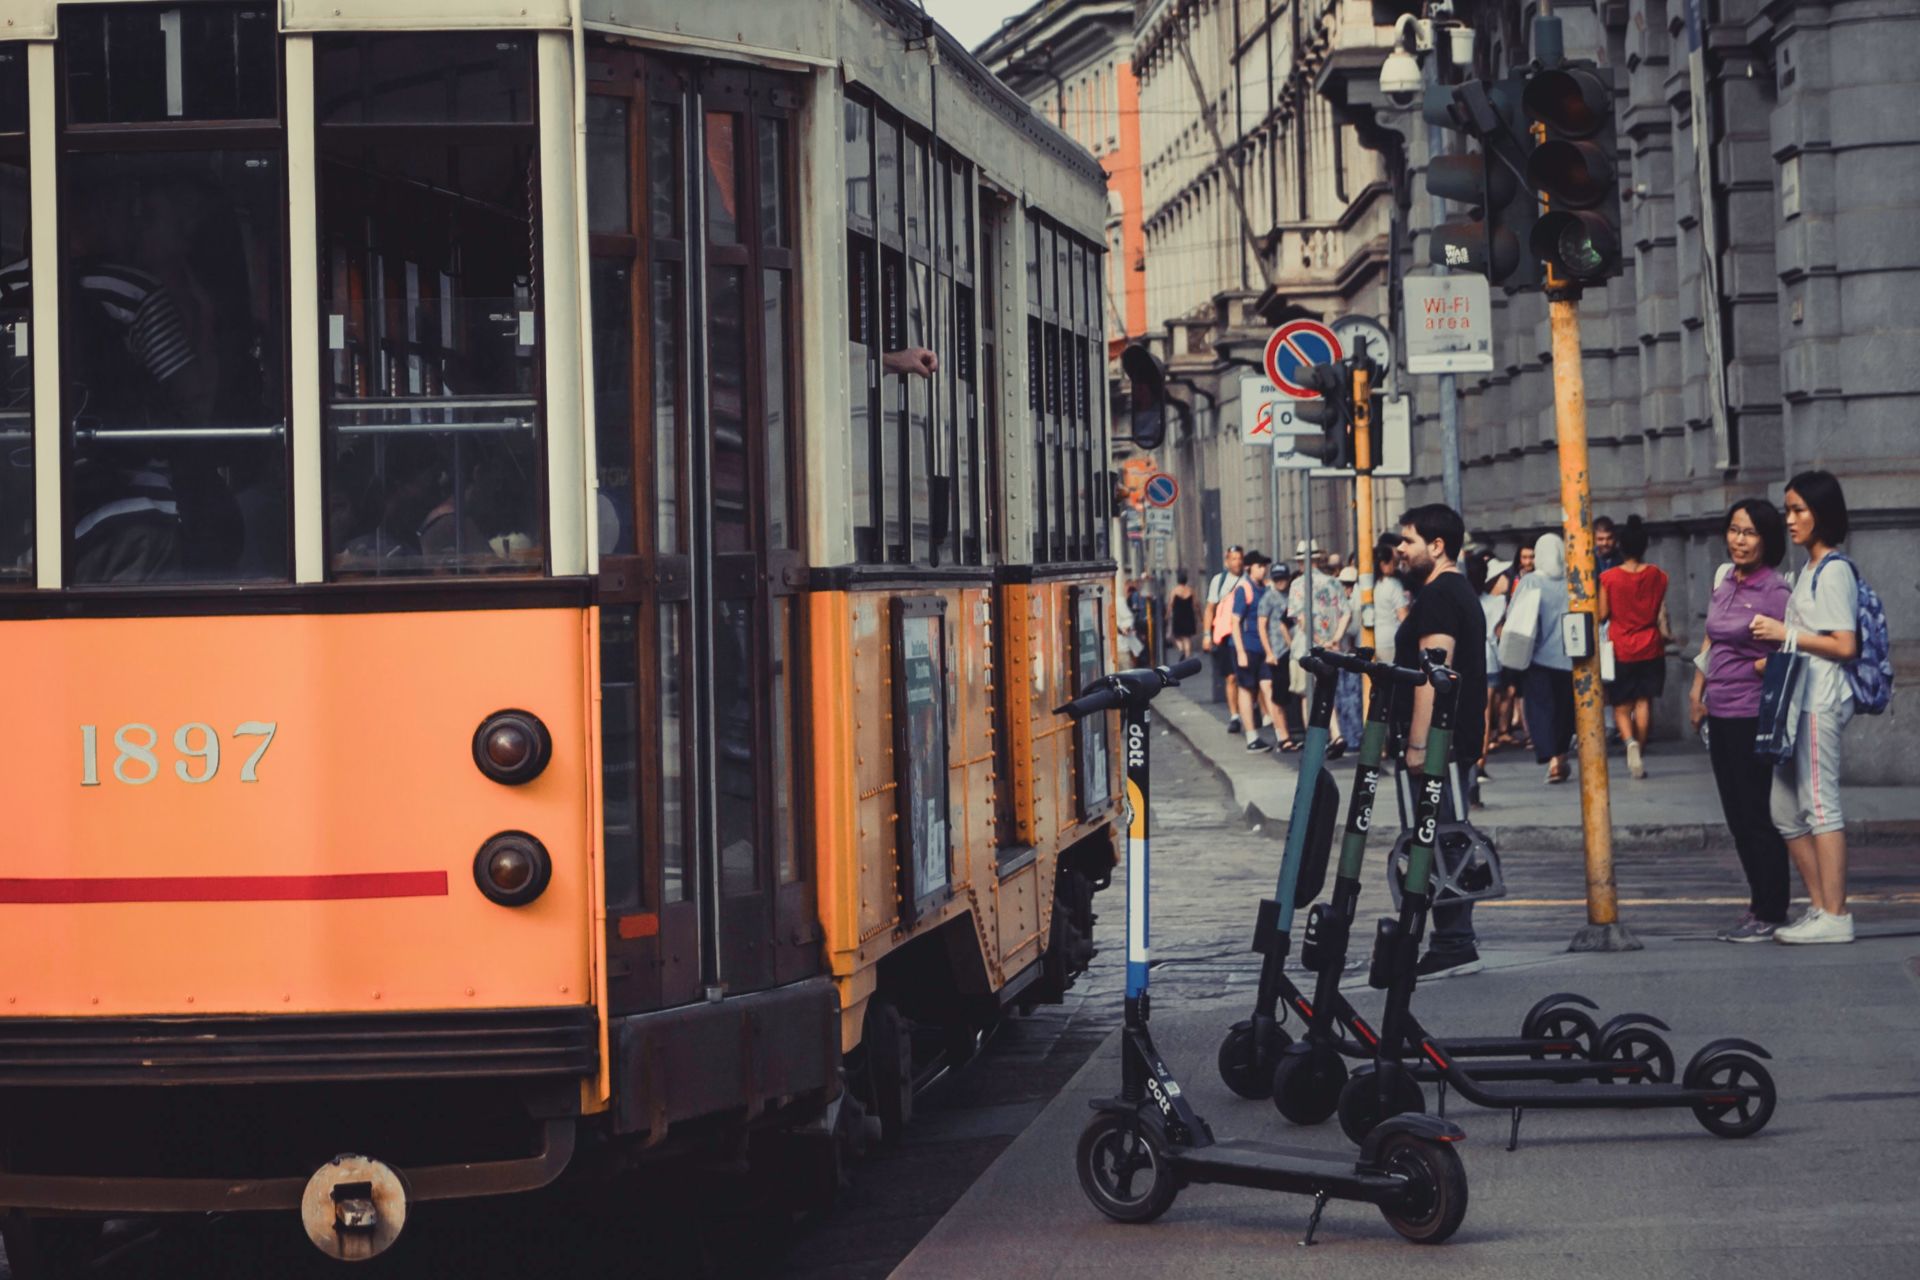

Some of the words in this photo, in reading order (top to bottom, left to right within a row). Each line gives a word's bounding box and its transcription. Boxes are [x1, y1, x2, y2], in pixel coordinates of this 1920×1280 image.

[1424, 297, 1470, 314] Wi-Fi
[1425, 317, 1470, 330] area
[80, 721, 277, 786] 1897
[1129, 724, 1144, 767] dott
[1147, 1078, 1171, 1115] dott
